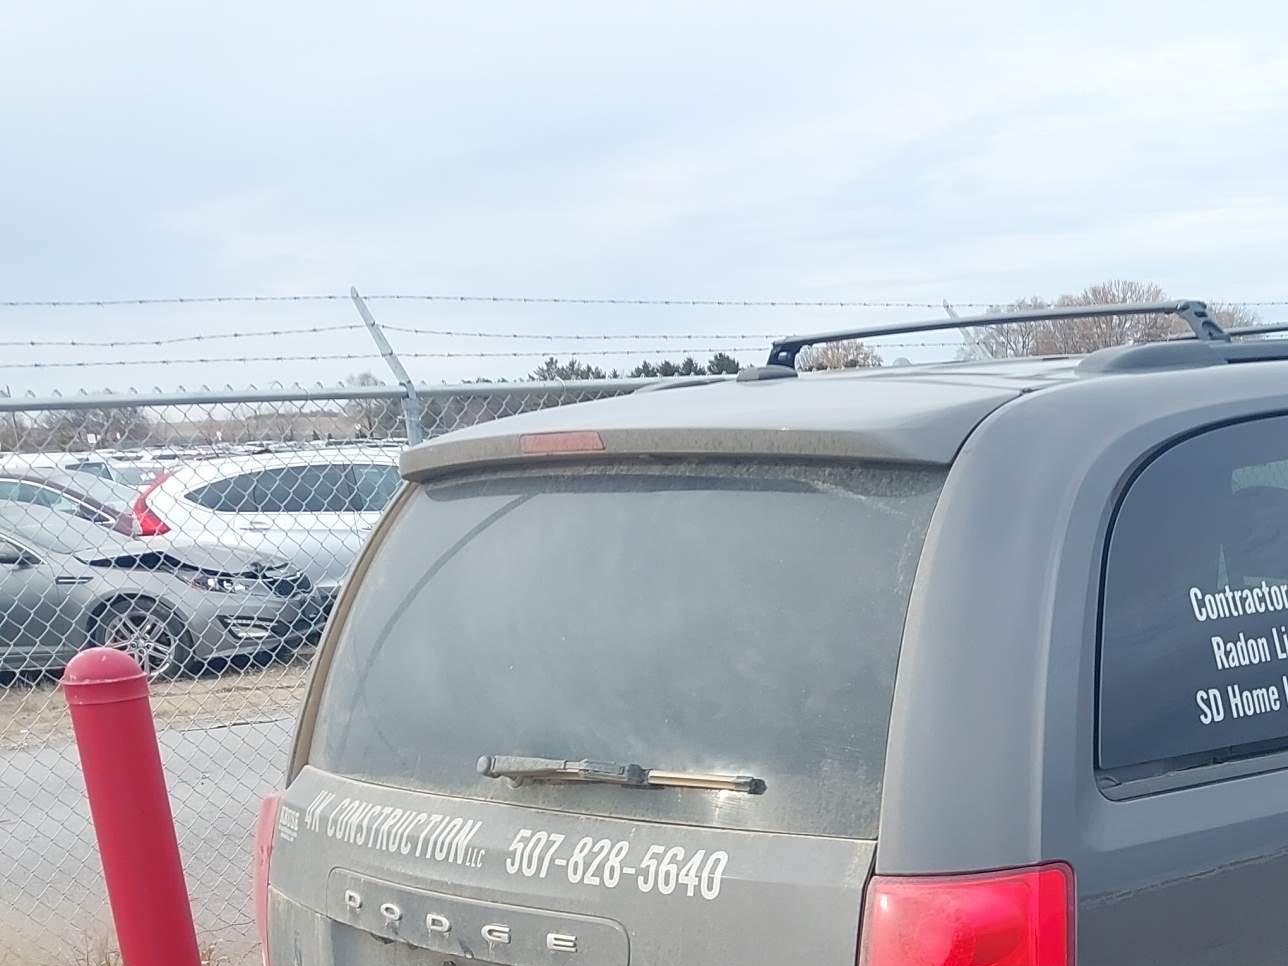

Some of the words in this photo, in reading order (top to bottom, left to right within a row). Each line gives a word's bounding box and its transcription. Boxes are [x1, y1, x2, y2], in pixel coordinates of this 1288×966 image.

[1211, 632, 1271, 670] Radon
[1196, 688, 1225, 725] SD
[1227, 684, 1281, 719] Home
[304, 790, 336, 833] 4K
[327, 797, 483, 865] CONSTRUCTION
[465, 847, 486, 868] LLC
[506, 829, 729, 900] 507-828-5640
[344, 889, 577, 953] DODGE
